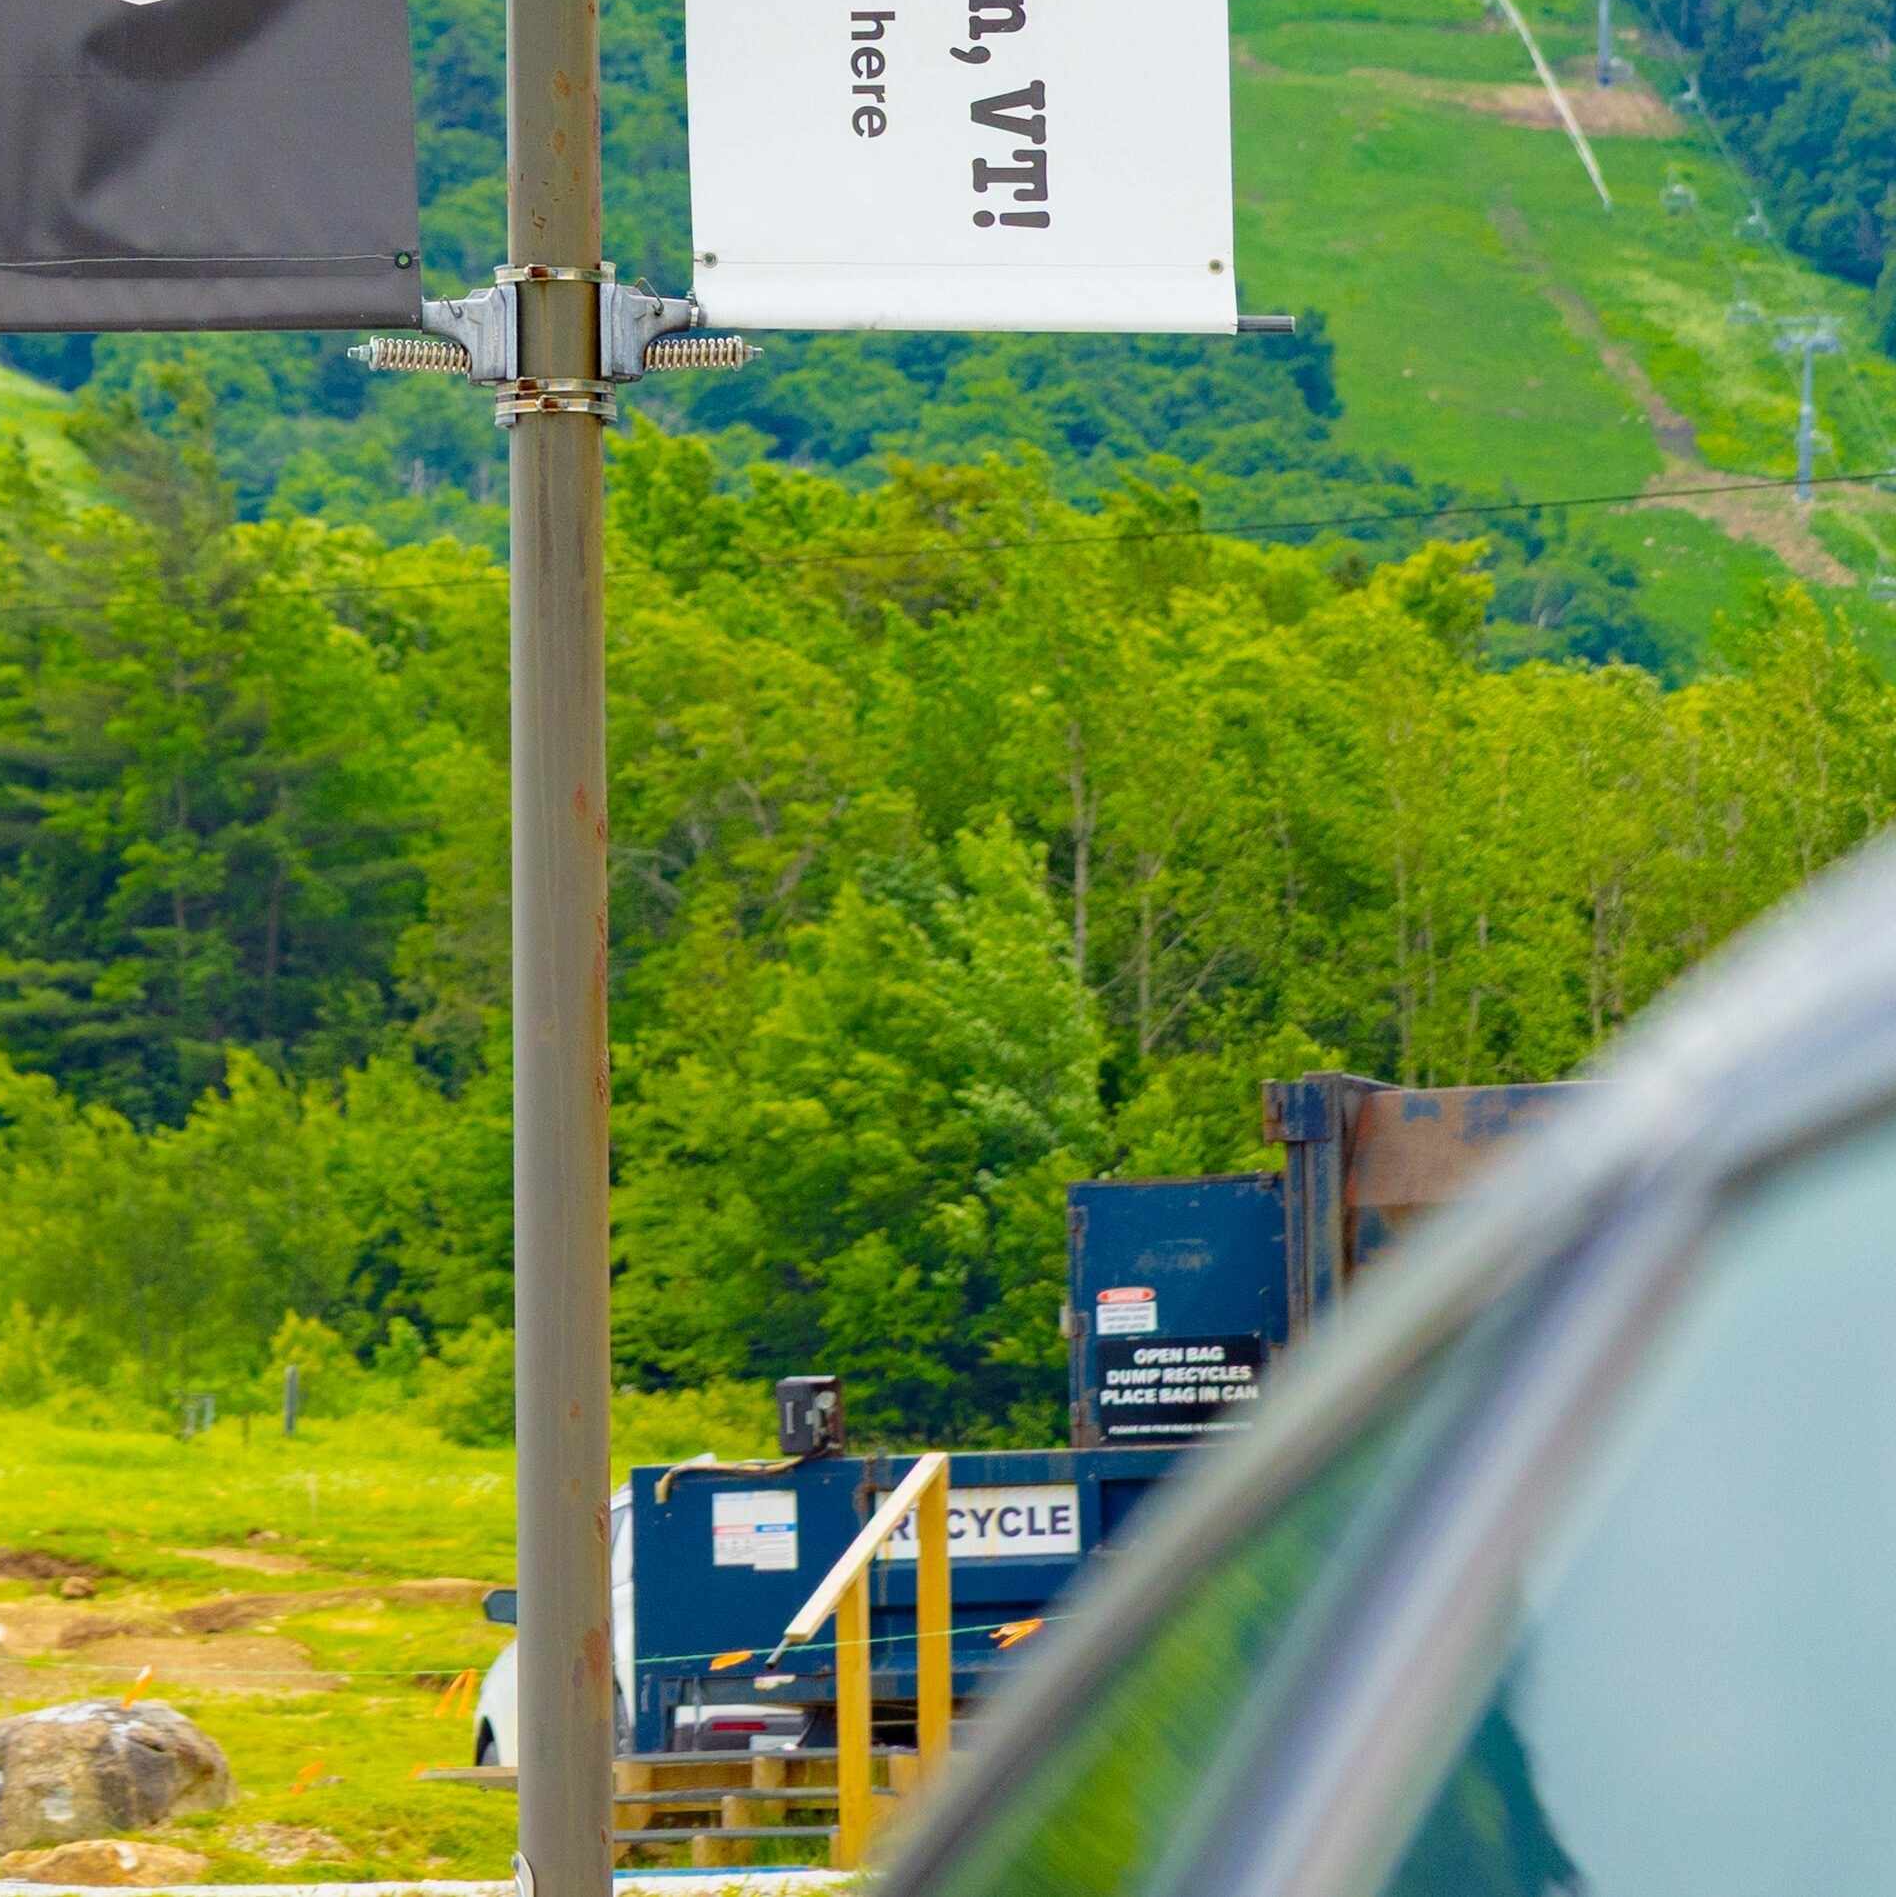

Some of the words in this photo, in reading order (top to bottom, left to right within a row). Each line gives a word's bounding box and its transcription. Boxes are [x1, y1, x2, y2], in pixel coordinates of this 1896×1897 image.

[850, 11, 896, 138] here
[970, 80, 1050, 229] VT!
[1133, 1347, 1184, 1364] OPEN
[1186, 1345, 1225, 1362] BAG
[1106, 1368, 1161, 1385] DUMP
[1162, 1365, 1252, 1384] RECYCLES
[1100, 1388, 1157, 1405] PLACE
[1159, 1386, 1197, 1404] BAG
[1199, 1385, 1220, 1402] IN
[1221, 1385, 1259, 1401] CAN
[887, 1505, 1072, 1541] RCYCLE
